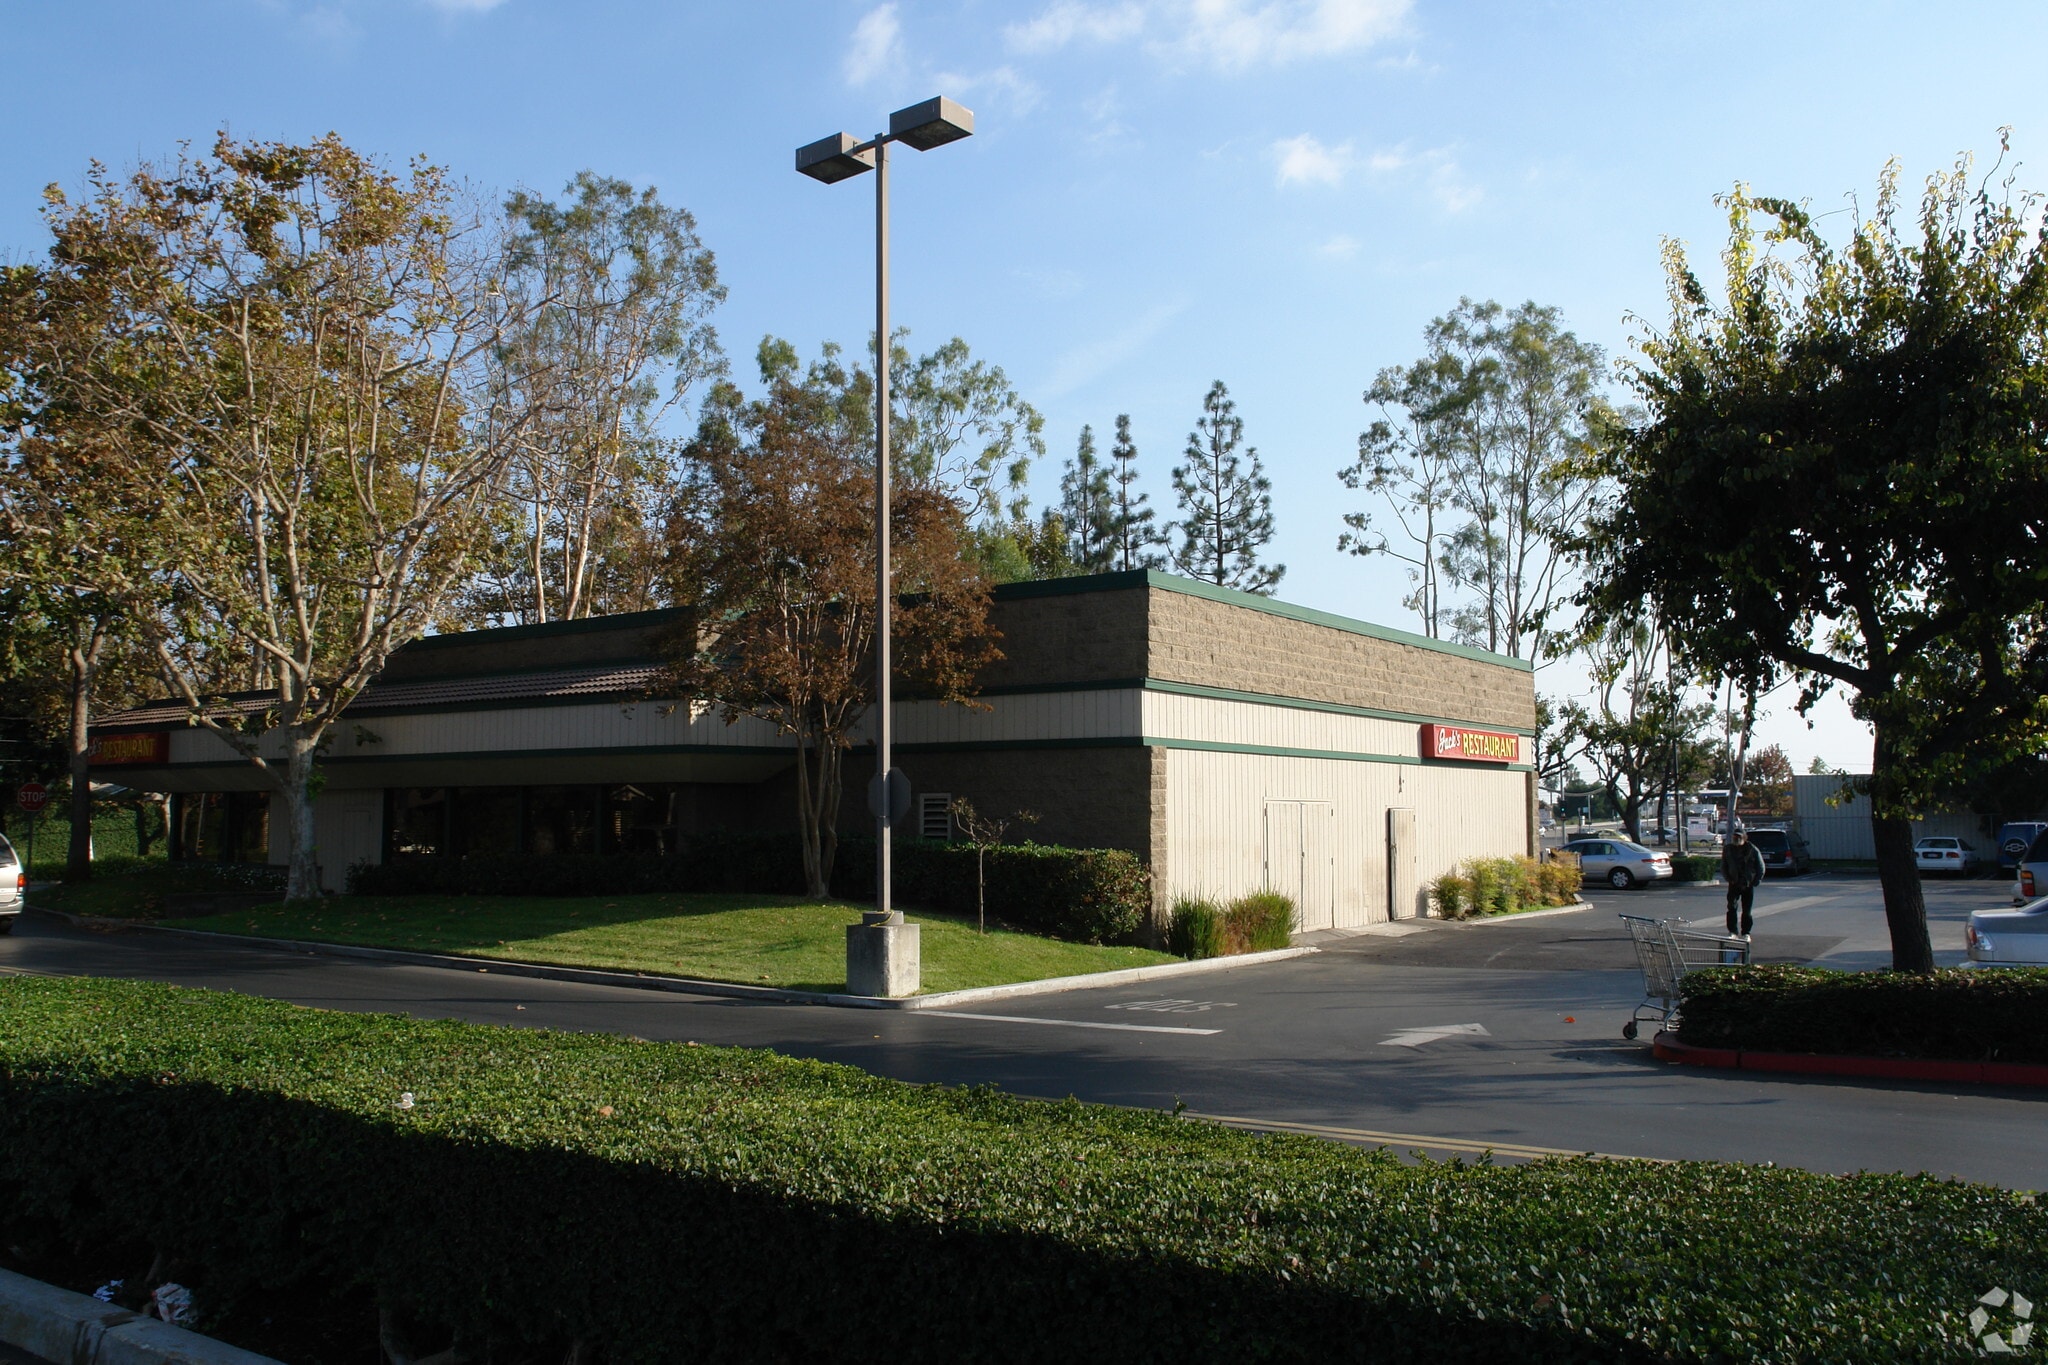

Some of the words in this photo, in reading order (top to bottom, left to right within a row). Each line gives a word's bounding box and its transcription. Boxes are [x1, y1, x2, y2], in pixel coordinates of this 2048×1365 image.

[103, 738, 156, 761] RESTAURANT
[1438, 729, 1461, 753] Jack's
[1463, 733, 1516, 758] RESTAURANT
[20, 791, 46, 802] STOP
